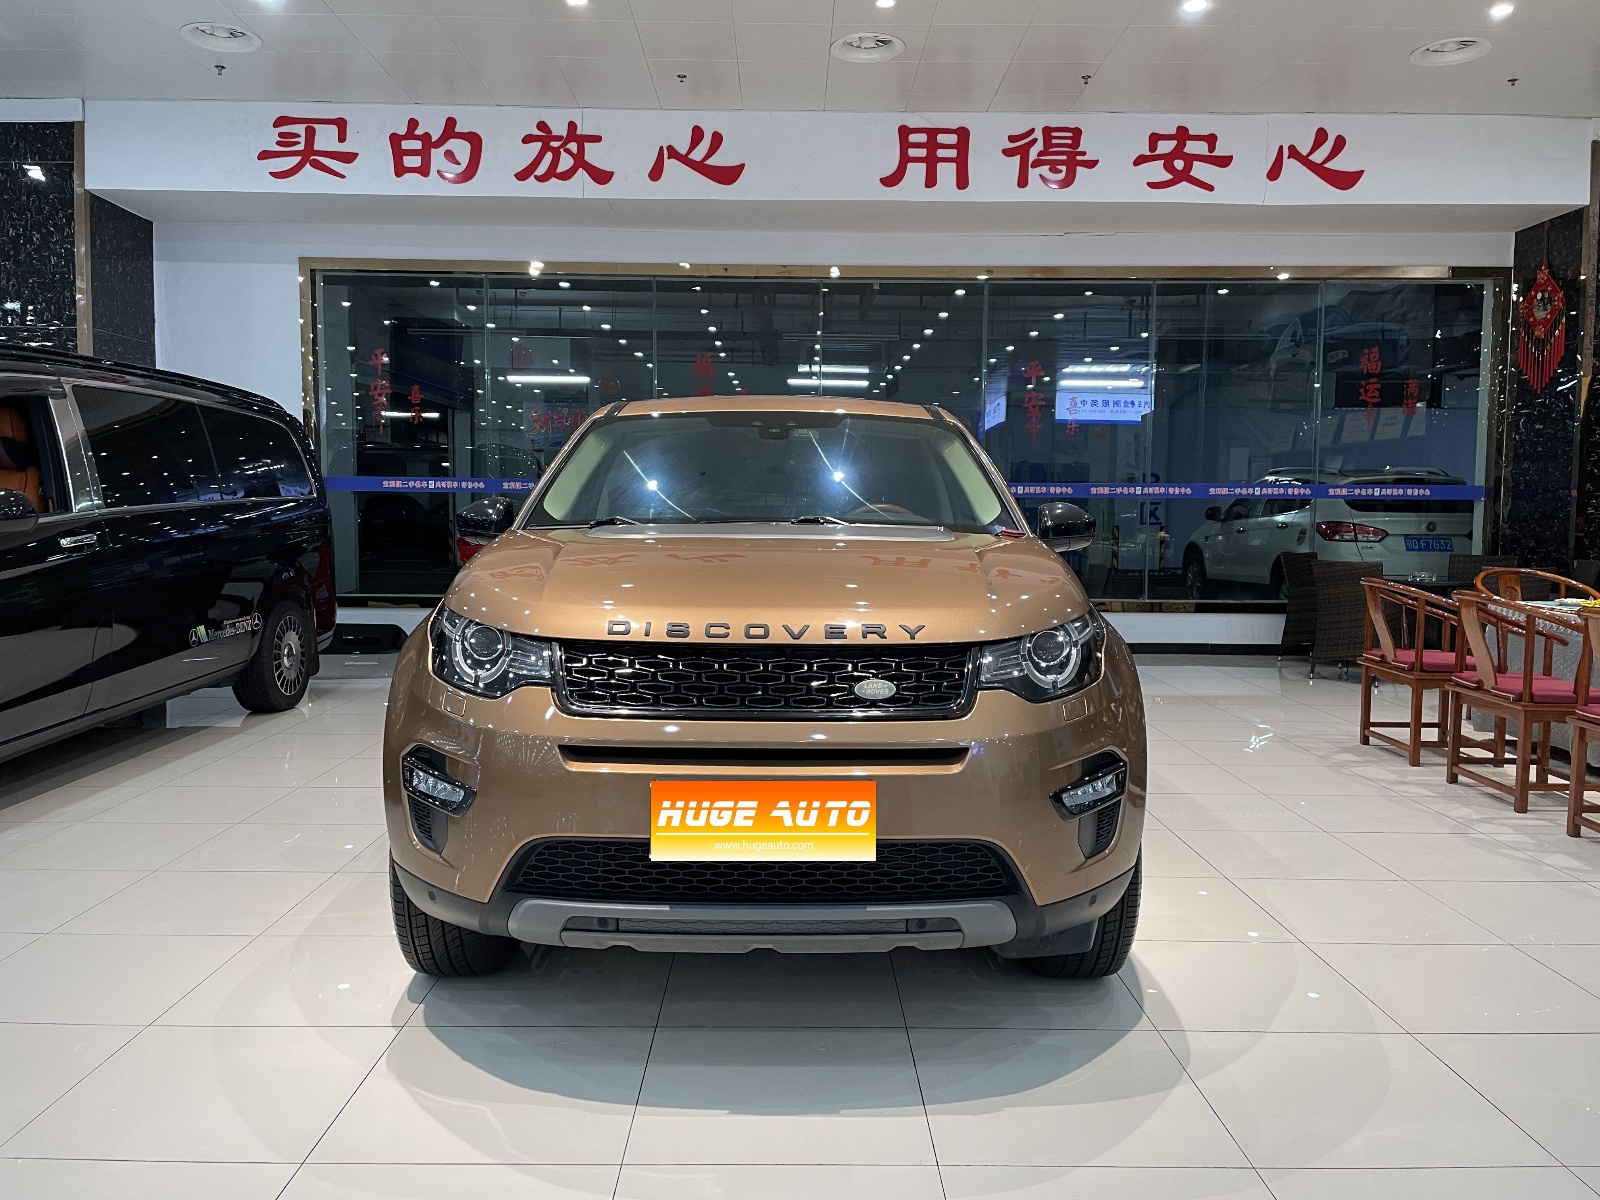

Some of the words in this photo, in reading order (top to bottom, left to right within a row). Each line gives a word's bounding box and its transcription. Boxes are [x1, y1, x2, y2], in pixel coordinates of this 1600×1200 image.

[257, 115, 746, 186] 买的放心
[879, 124, 1366, 191] 用得安心
[369, 348, 391, 406] 平安
[1023, 360, 1046, 418] 平安
[607, 619, 926, 640] DISCOVERY
